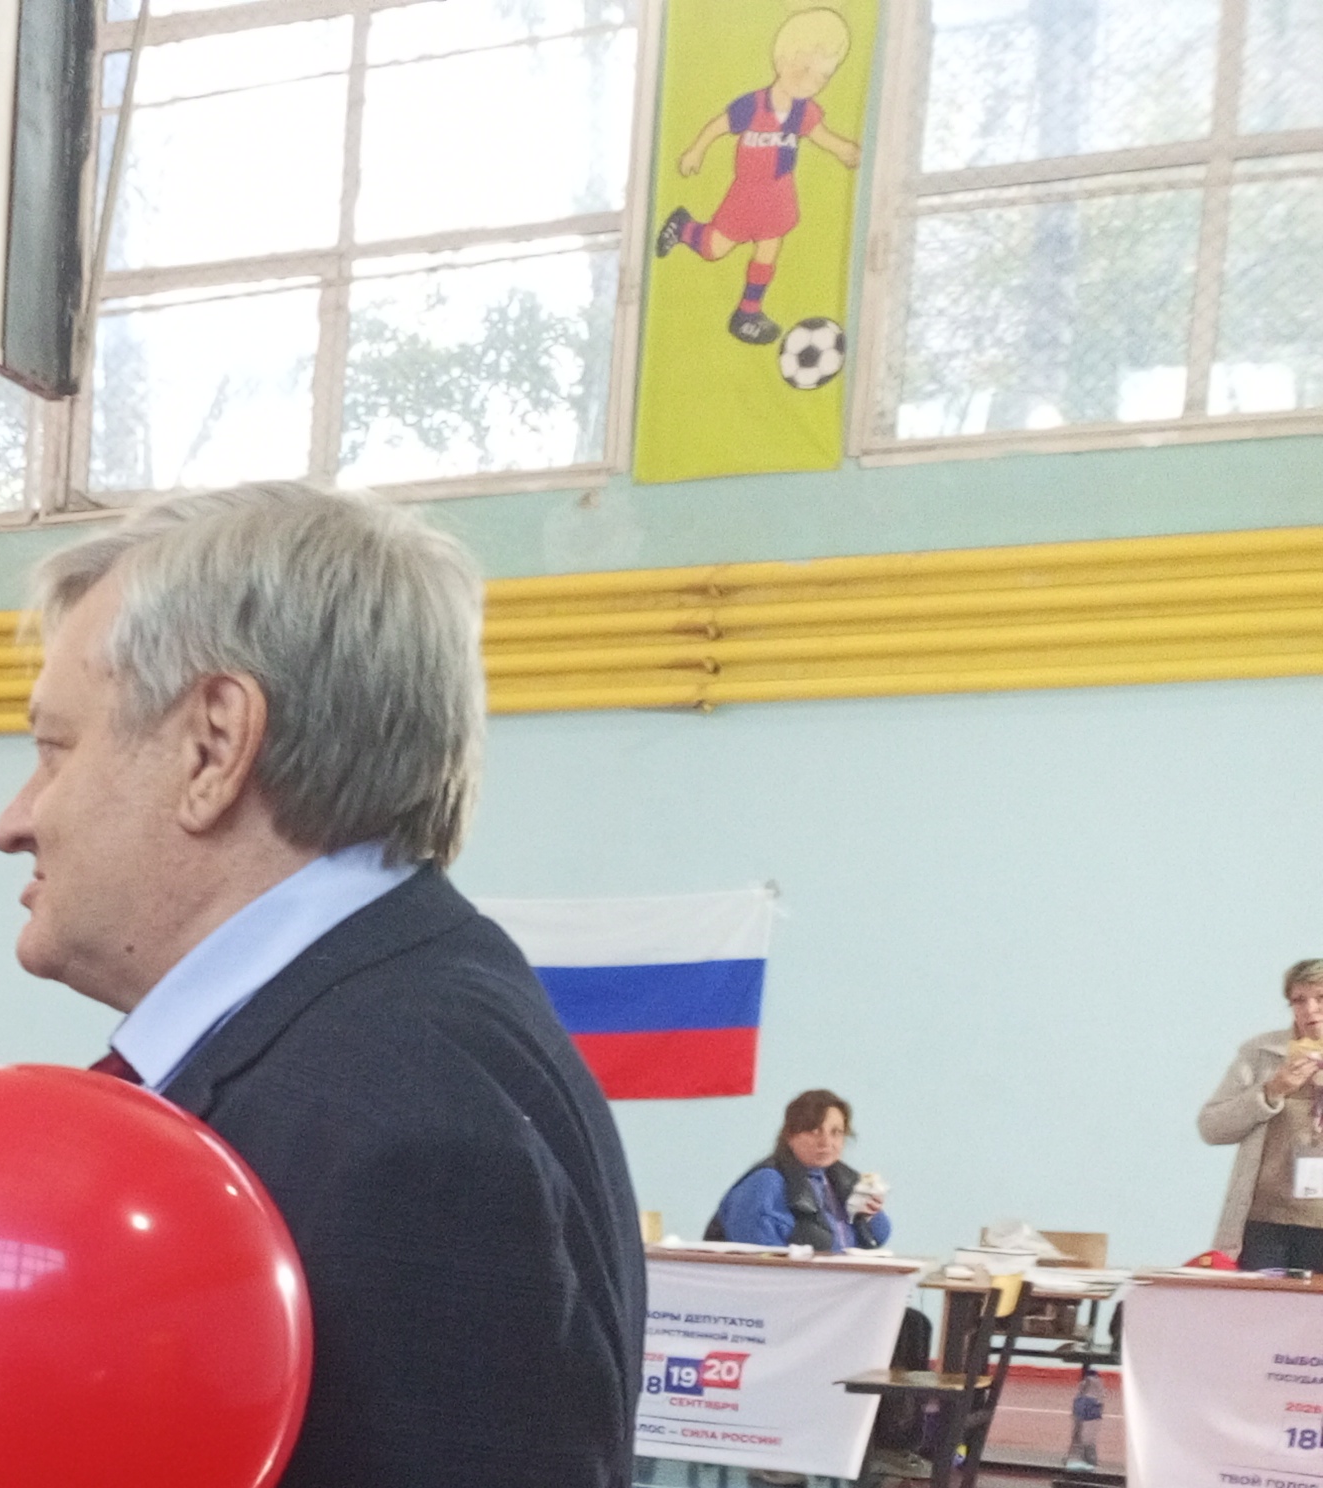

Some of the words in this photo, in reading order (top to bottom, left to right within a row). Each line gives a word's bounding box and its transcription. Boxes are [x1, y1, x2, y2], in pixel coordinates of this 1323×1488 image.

[743, 130, 797, 148] ЦСКА
[684, 1314, 764, 1329] ДЕПУТАТОВ
[730, 1334, 766, 1344] ДУМЫ
[645, 1376, 662, 1394] 8
[668, 1366, 697, 1388] 19
[702, 1359, 740, 1382] 20
[669, 1397, 739, 1412] СЕНТЯБРЯ
[680, 1428, 718, 1440] СИЛА
[1285, 1427, 1318, 1450] 18
[1219, 1473, 1262, 1486] ТВОЙ
